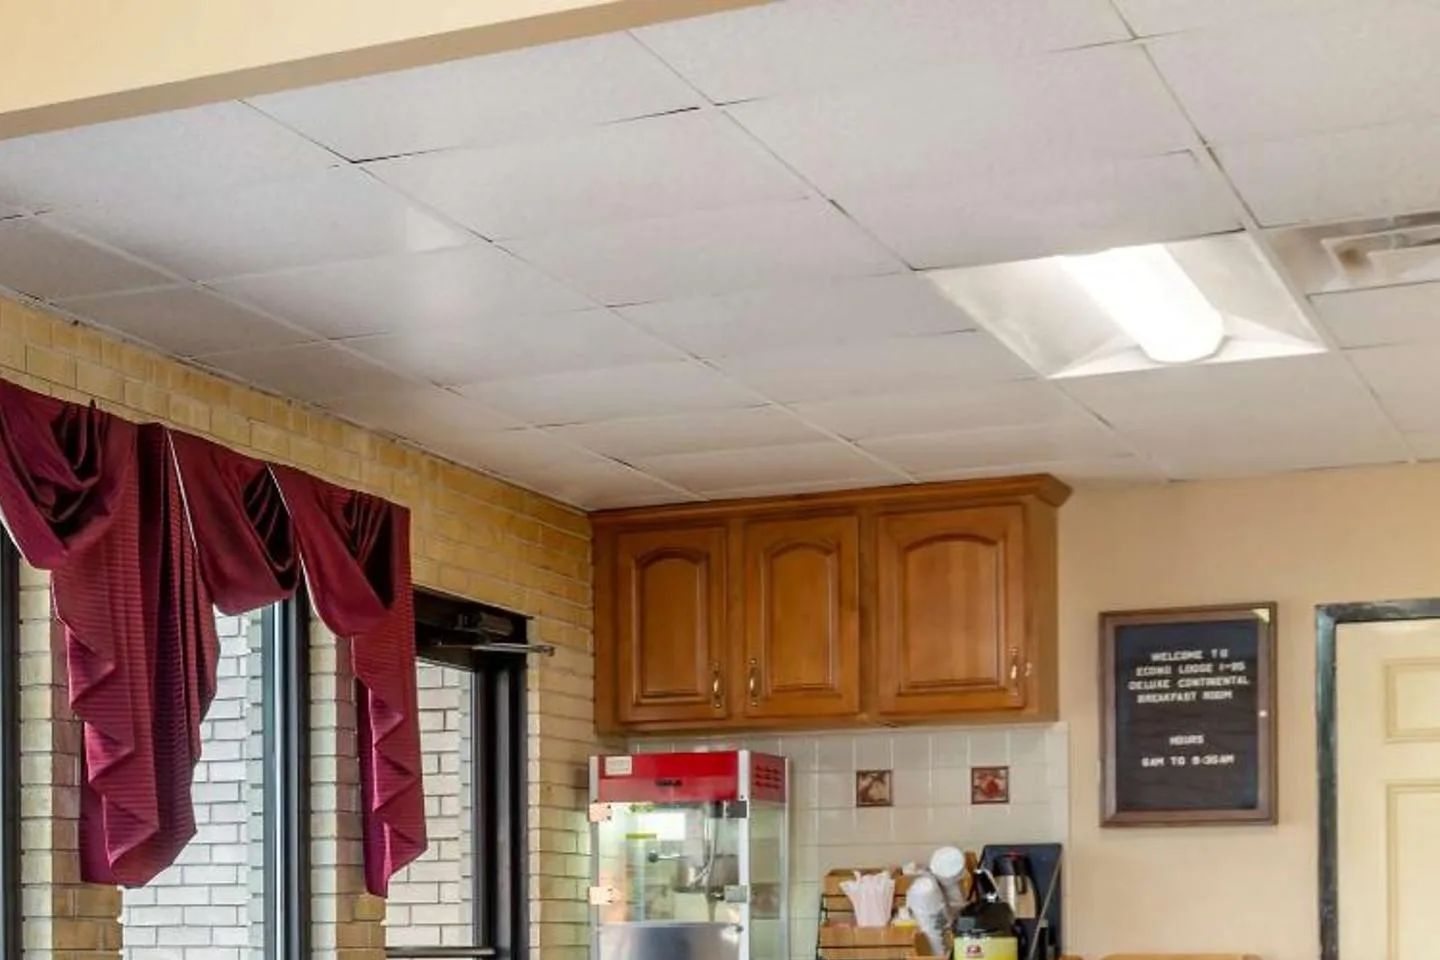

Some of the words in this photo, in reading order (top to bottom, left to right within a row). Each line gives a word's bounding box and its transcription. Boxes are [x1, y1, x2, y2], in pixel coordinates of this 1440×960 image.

[1151, 650, 1203, 661] WELCOME
[1177, 675, 1250, 688] CONTINENTAL
[1136, 691, 1197, 704] BREAKFAST
[1202, 690, 1233, 700] ROOM
[1170, 755, 1185, 765] TO
